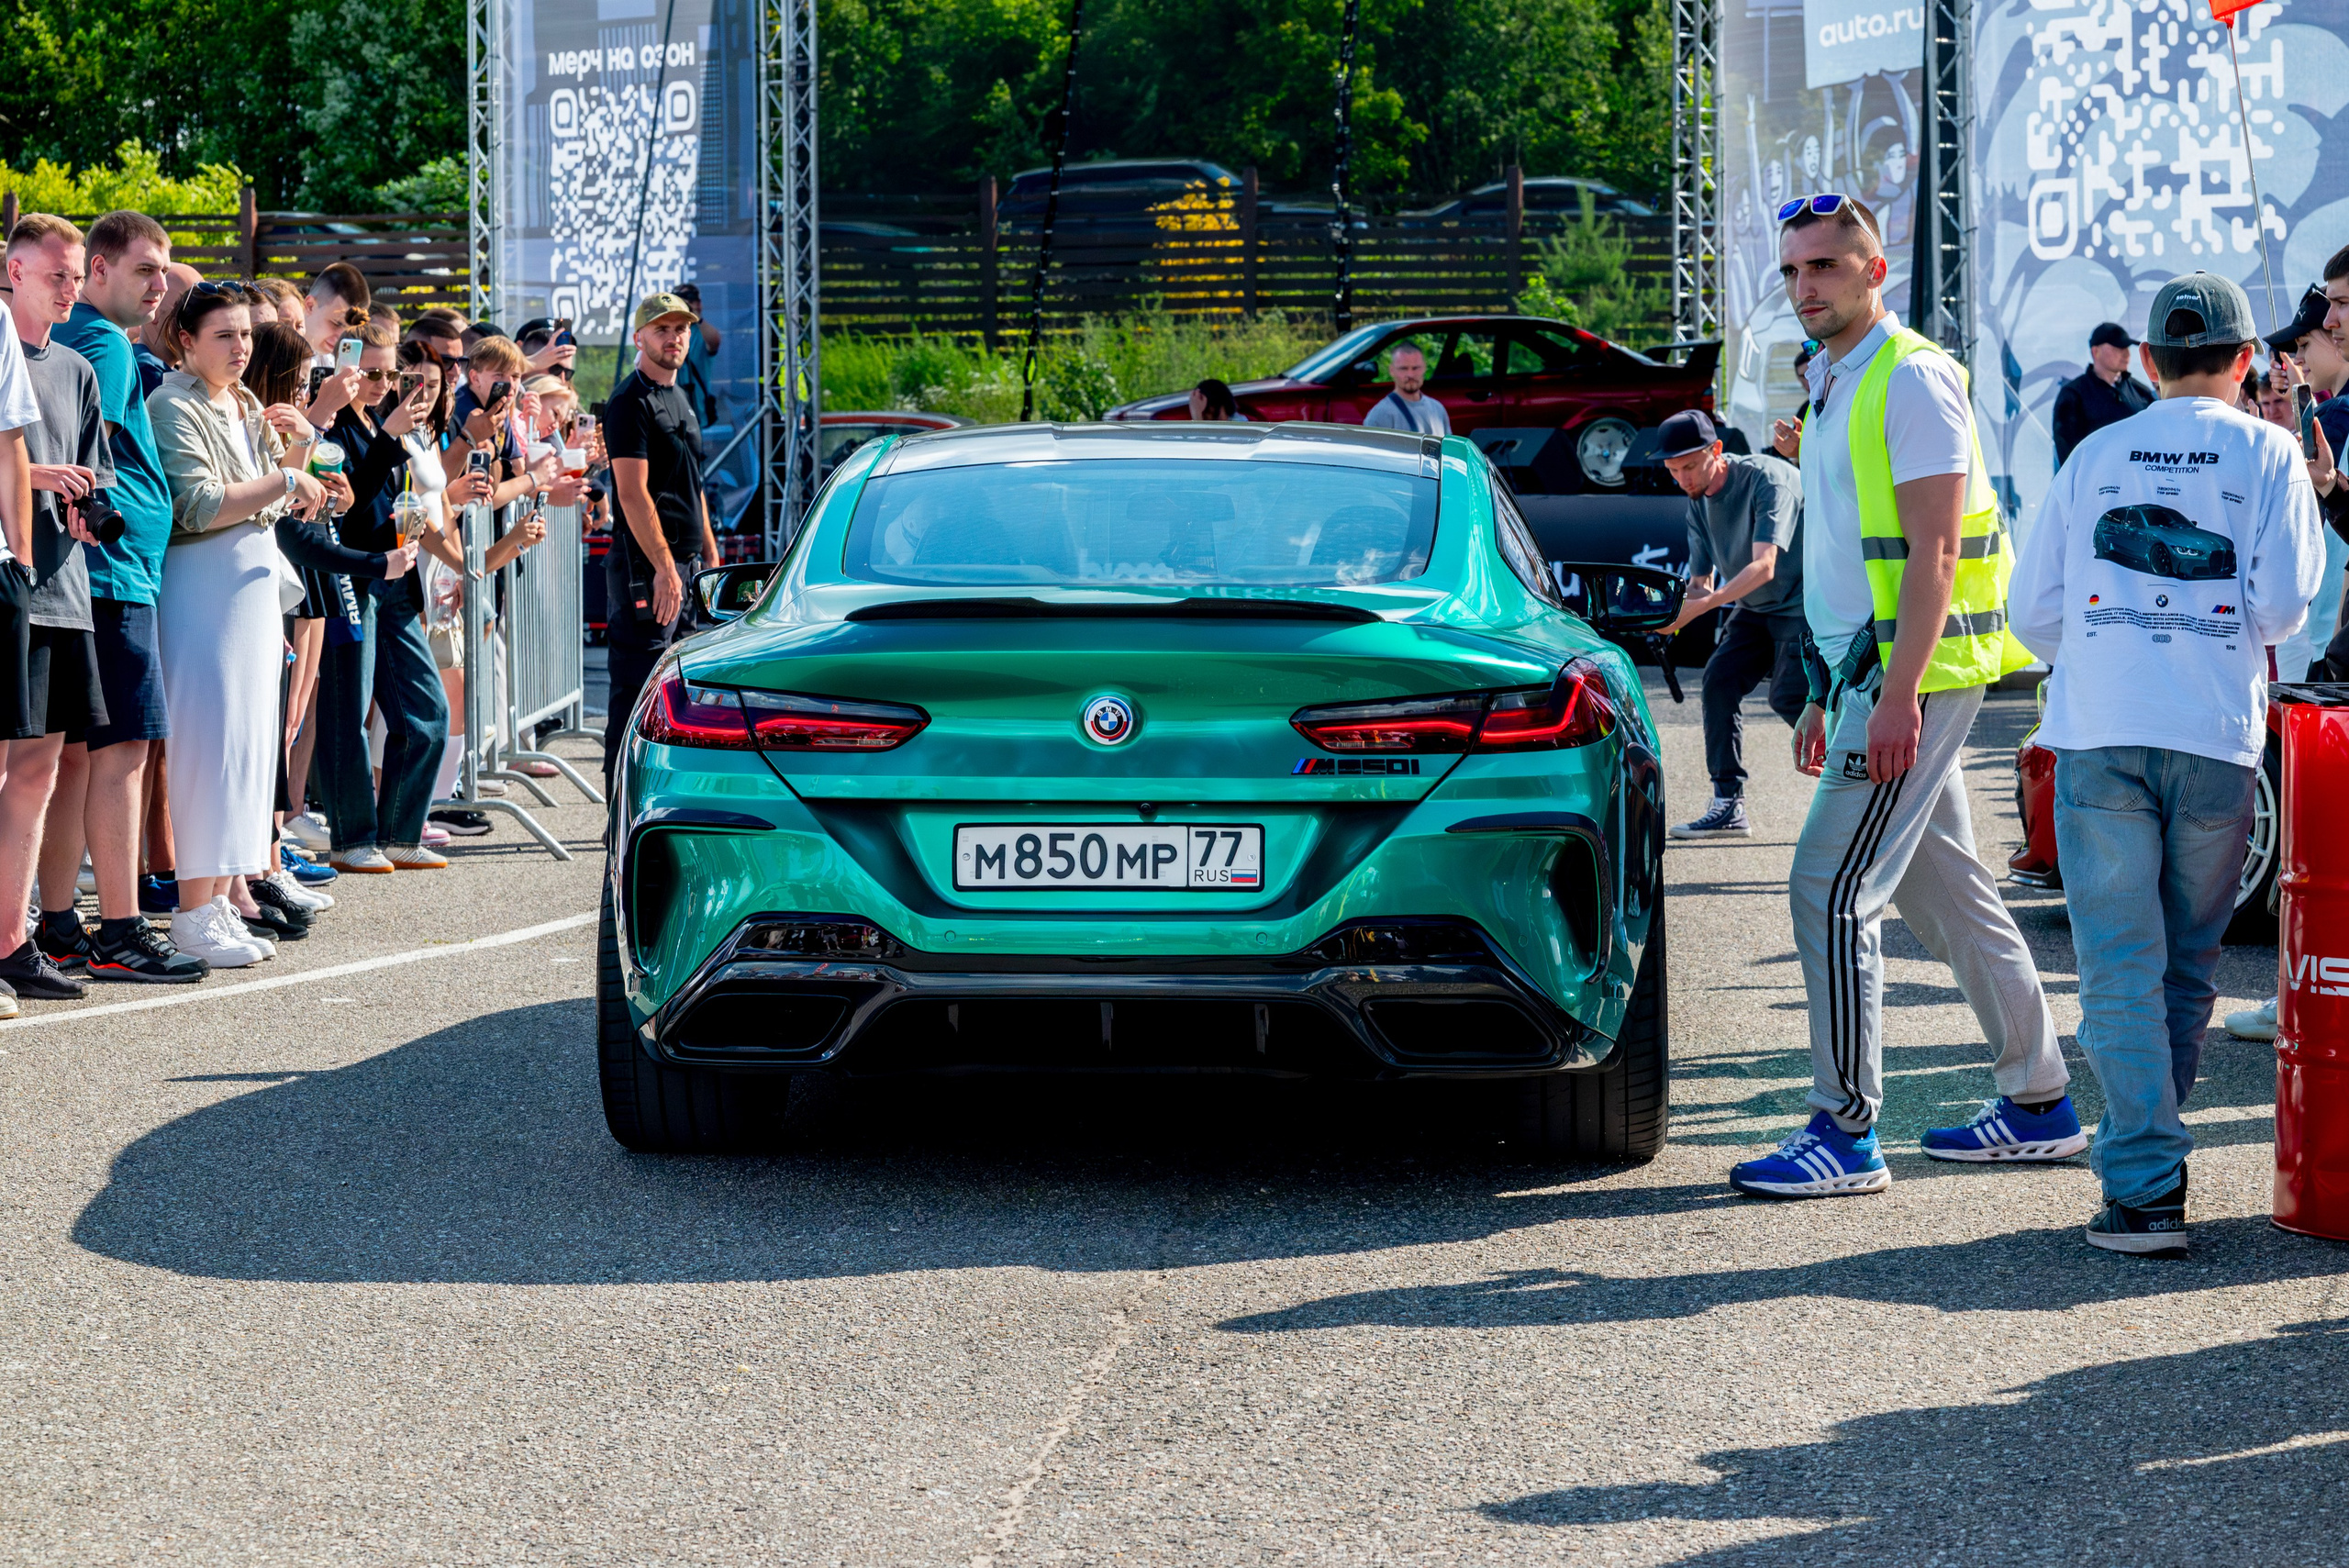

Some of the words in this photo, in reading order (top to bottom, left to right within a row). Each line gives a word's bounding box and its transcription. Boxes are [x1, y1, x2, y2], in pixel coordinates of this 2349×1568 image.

[1819, 6, 1925, 48] auto.ru
[548, 49, 603, 82] мерч
[607, 46, 635, 72] на
[640, 41, 696, 70] озон
[2129, 450, 2184, 465] BMW
[2188, 452, 2220, 464] M3
[2144, 464, 2199, 473] COMPETITION
[1845, 770, 1867, 778] adidas
[1195, 830, 1242, 867] 77
[1194, 870, 1230, 883] RUS
